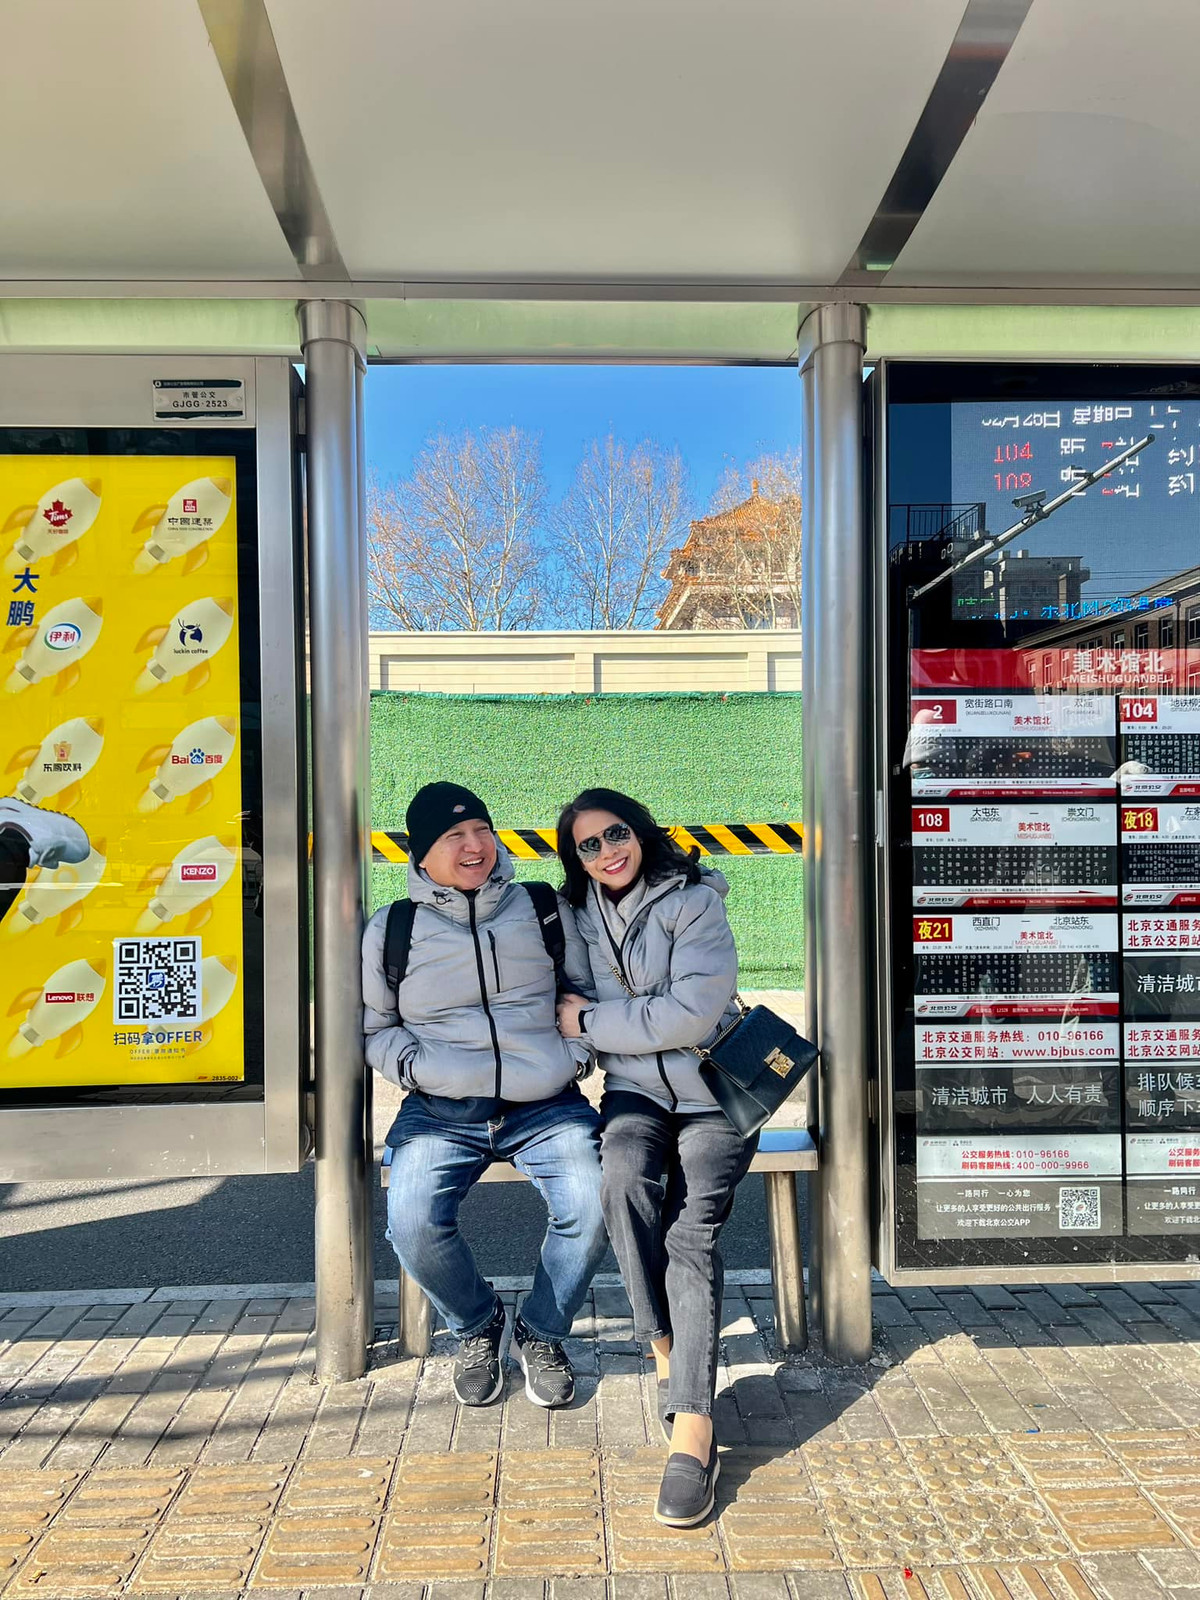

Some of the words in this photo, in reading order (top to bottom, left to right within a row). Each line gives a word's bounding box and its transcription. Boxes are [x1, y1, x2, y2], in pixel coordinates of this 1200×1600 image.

[994, 441, 1034, 464] 104
[48, 510, 69, 522] Tims
[49, 631, 76, 643] 伊利
[1073, 651, 1165, 673] 美术馆北
[965, 698, 1013, 709] 宽街路口南
[1170, 698, 1200, 708] 地铁柳
[932, 704, 944, 719] 2
[1122, 702, 1154, 718] 104
[1014, 715, 1052, 726] 美术馆北
[205, 754, 222, 764] 百度
[972, 807, 1000, 817] 大屯东
[1067, 807, 1095, 817] 崇文门
[918, 813, 943, 827] 108
[1124, 810, 1154, 830] 夜18
[1018, 822, 1051, 832] 美术馆北
[183, 867, 214, 876] KENZO
[972, 916, 1001, 927] 西直门
[1053, 916, 1090, 926] 北京站东
[918, 920, 949, 940] 夜21
[1020, 931, 1054, 940] 美术馆北
[1137, 973, 1200, 993] 清洁城
[77, 992, 94, 1002] 联想
[113, 1030, 203, 1046] 扫码拿OFFER
[1012, 1046, 1115, 1058] www.bjbus.com
[1137, 1072, 1200, 1092] 排队候
[931, 1085, 1009, 1106] 清洁城市
[1026, 1084, 1102, 1104] 人人有责
[1137, 1098, 1200, 1117] 顺序下
[957, 1189, 989, 1198] 一路同行
[998, 1189, 1031, 1198] 一心为您
[1163, 1186, 1196, 1196] 一路同行
[936, 1203, 1051, 1213] 让更多的人享受更好的公共出行服务
[957, 1218, 1031, 1227] 欢迎下载北京公交APP
